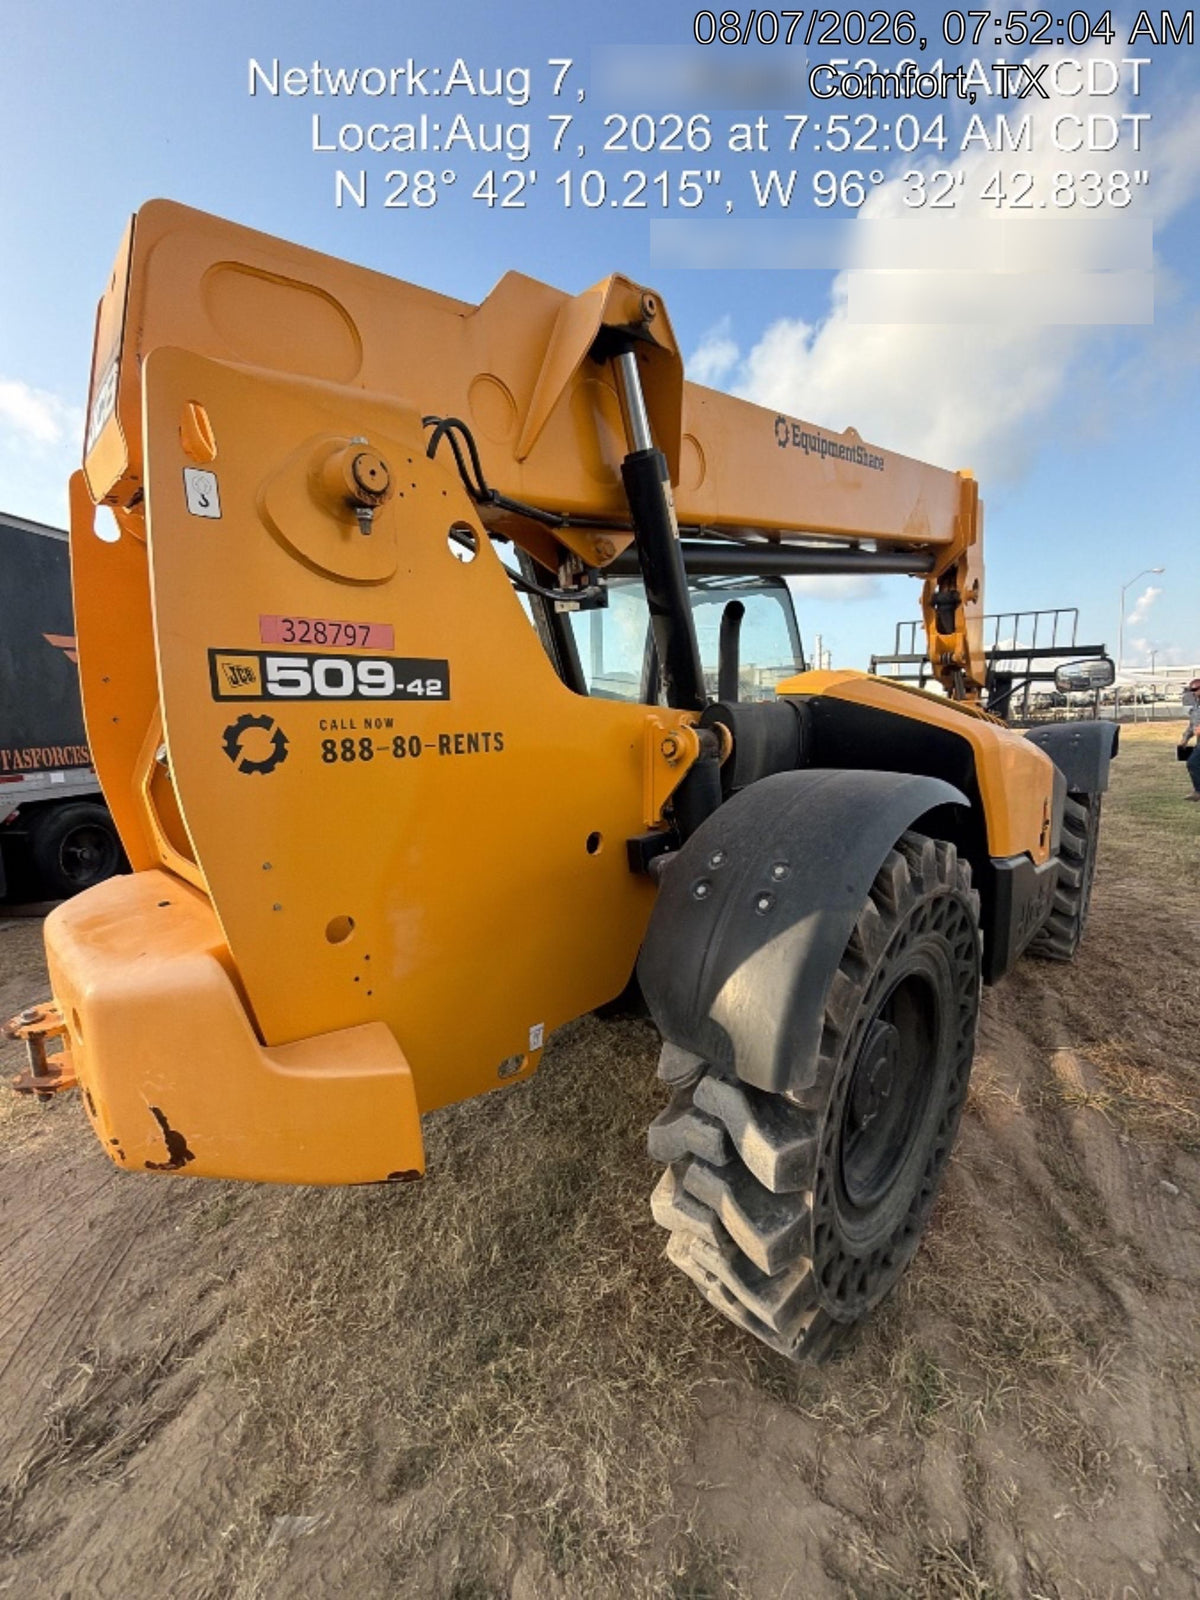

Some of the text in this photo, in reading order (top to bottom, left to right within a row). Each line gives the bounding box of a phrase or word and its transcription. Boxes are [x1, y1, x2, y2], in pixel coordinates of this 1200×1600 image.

[791, 423, 885, 472] EquipmentShare
[281, 617, 372, 647] 328797
[226, 656, 443, 697] JCB 509-42
[319, 717, 395, 732] CALL NOW
[321, 731, 505, 764] 888-80-RENTS
